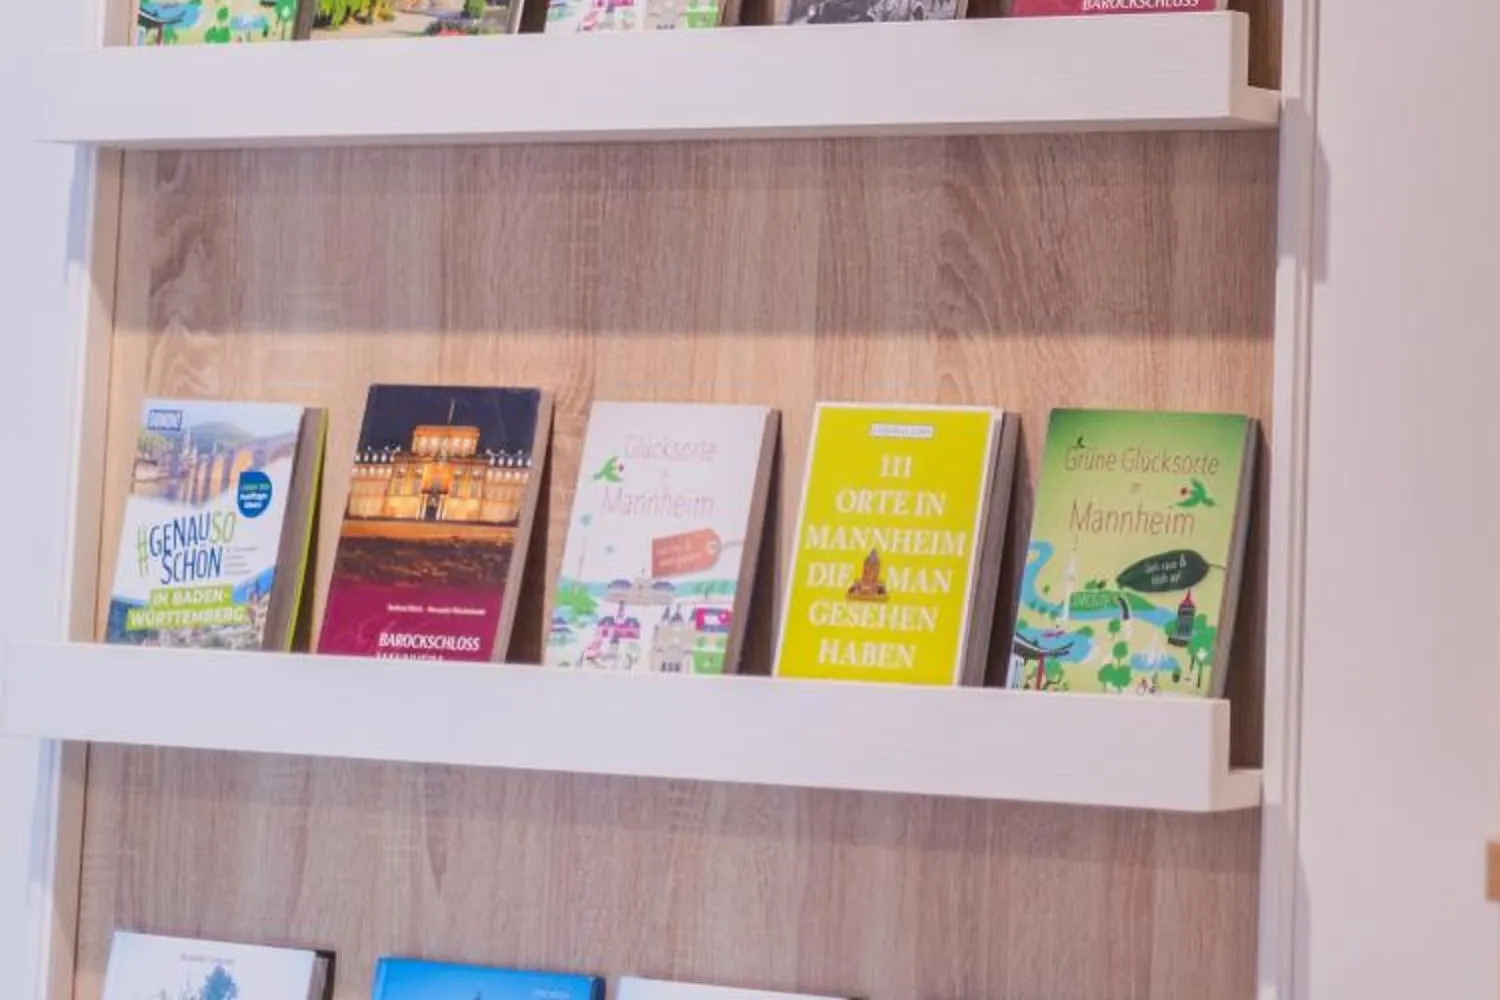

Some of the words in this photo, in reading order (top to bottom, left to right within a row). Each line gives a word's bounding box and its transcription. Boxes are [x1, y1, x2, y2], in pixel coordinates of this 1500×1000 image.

[601, 484, 715, 519] Mannheim
[835, 488, 909, 515] ORTE
[913, 491, 947, 518] IN
[1069, 500, 1196, 536] Mannheim
[804, 523, 967, 557] MANNHEIM
[807, 561, 853, 588] DIE
[887, 565, 954, 594] MAN
[808, 600, 939, 633] GESEHEN
[378, 632, 481, 652] BAROCKSCHLOSS
[817, 638, 916, 669] HABEN
